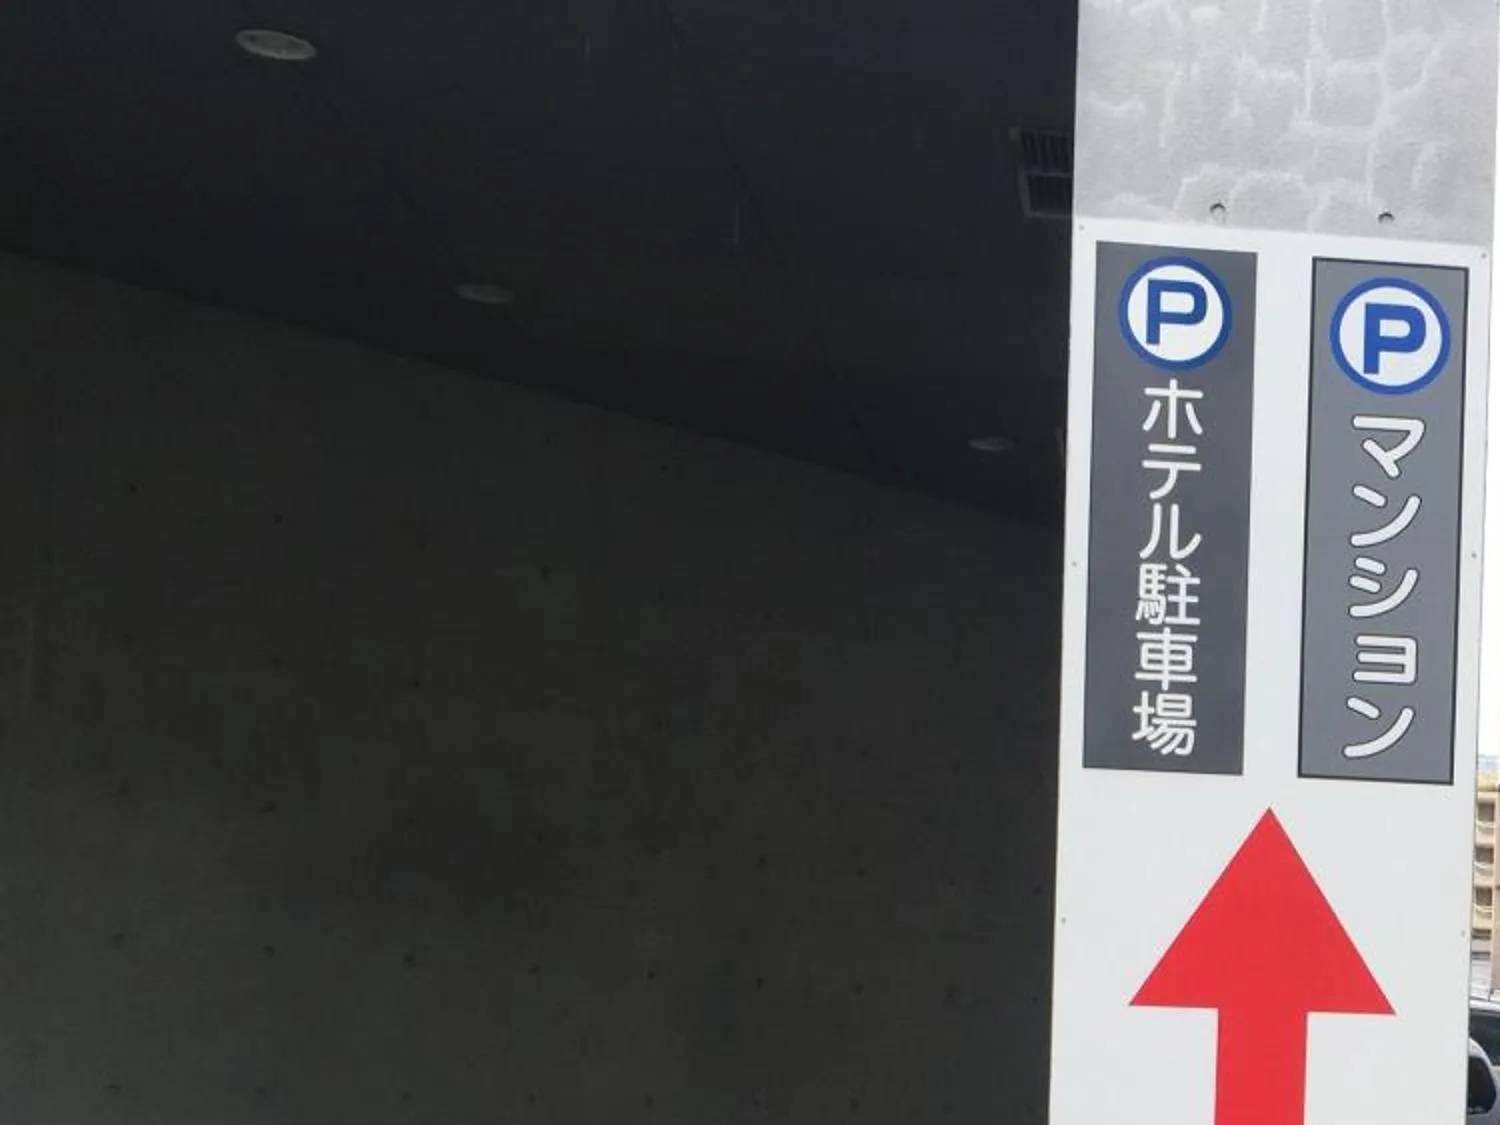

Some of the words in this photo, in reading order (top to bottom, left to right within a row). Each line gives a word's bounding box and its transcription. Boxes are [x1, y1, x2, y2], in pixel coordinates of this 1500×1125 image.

[1146, 278, 1208, 345] P
[1363, 302, 1427, 375] P
[1131, 378, 1204, 757] ホテル駐車場
